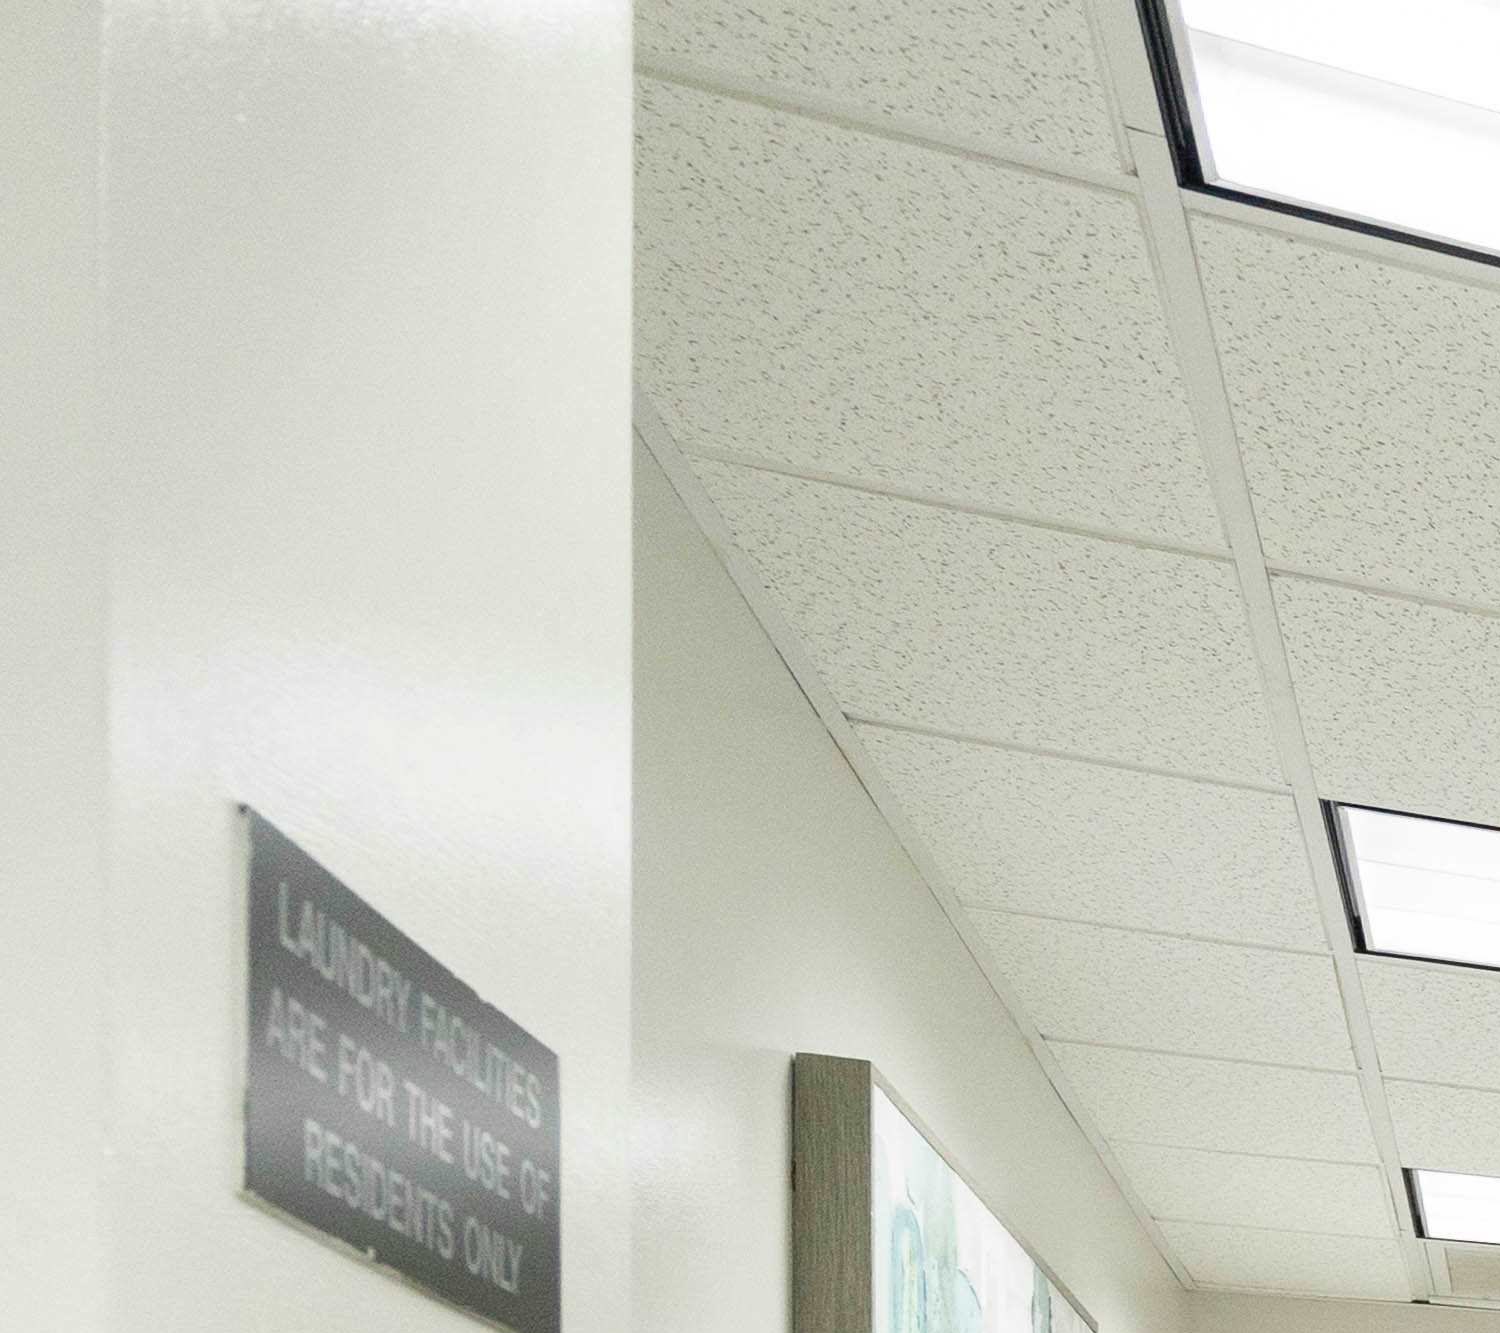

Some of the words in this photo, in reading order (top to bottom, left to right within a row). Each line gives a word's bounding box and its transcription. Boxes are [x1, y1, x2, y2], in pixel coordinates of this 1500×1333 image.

[268, 988, 327, 1081] ARE
[338, 1037, 396, 1128] FOR
[401, 1081, 453, 1164] THE
[464, 1120, 510, 1199] USE
[521, 1159, 550, 1217] OF
[279, 882, 411, 1033] LAUNDRY
[420, 996, 542, 1128] FACILITIES
[304, 1118, 453, 1259] RESIDENTS
[464, 1217, 523, 1293] ONLY
